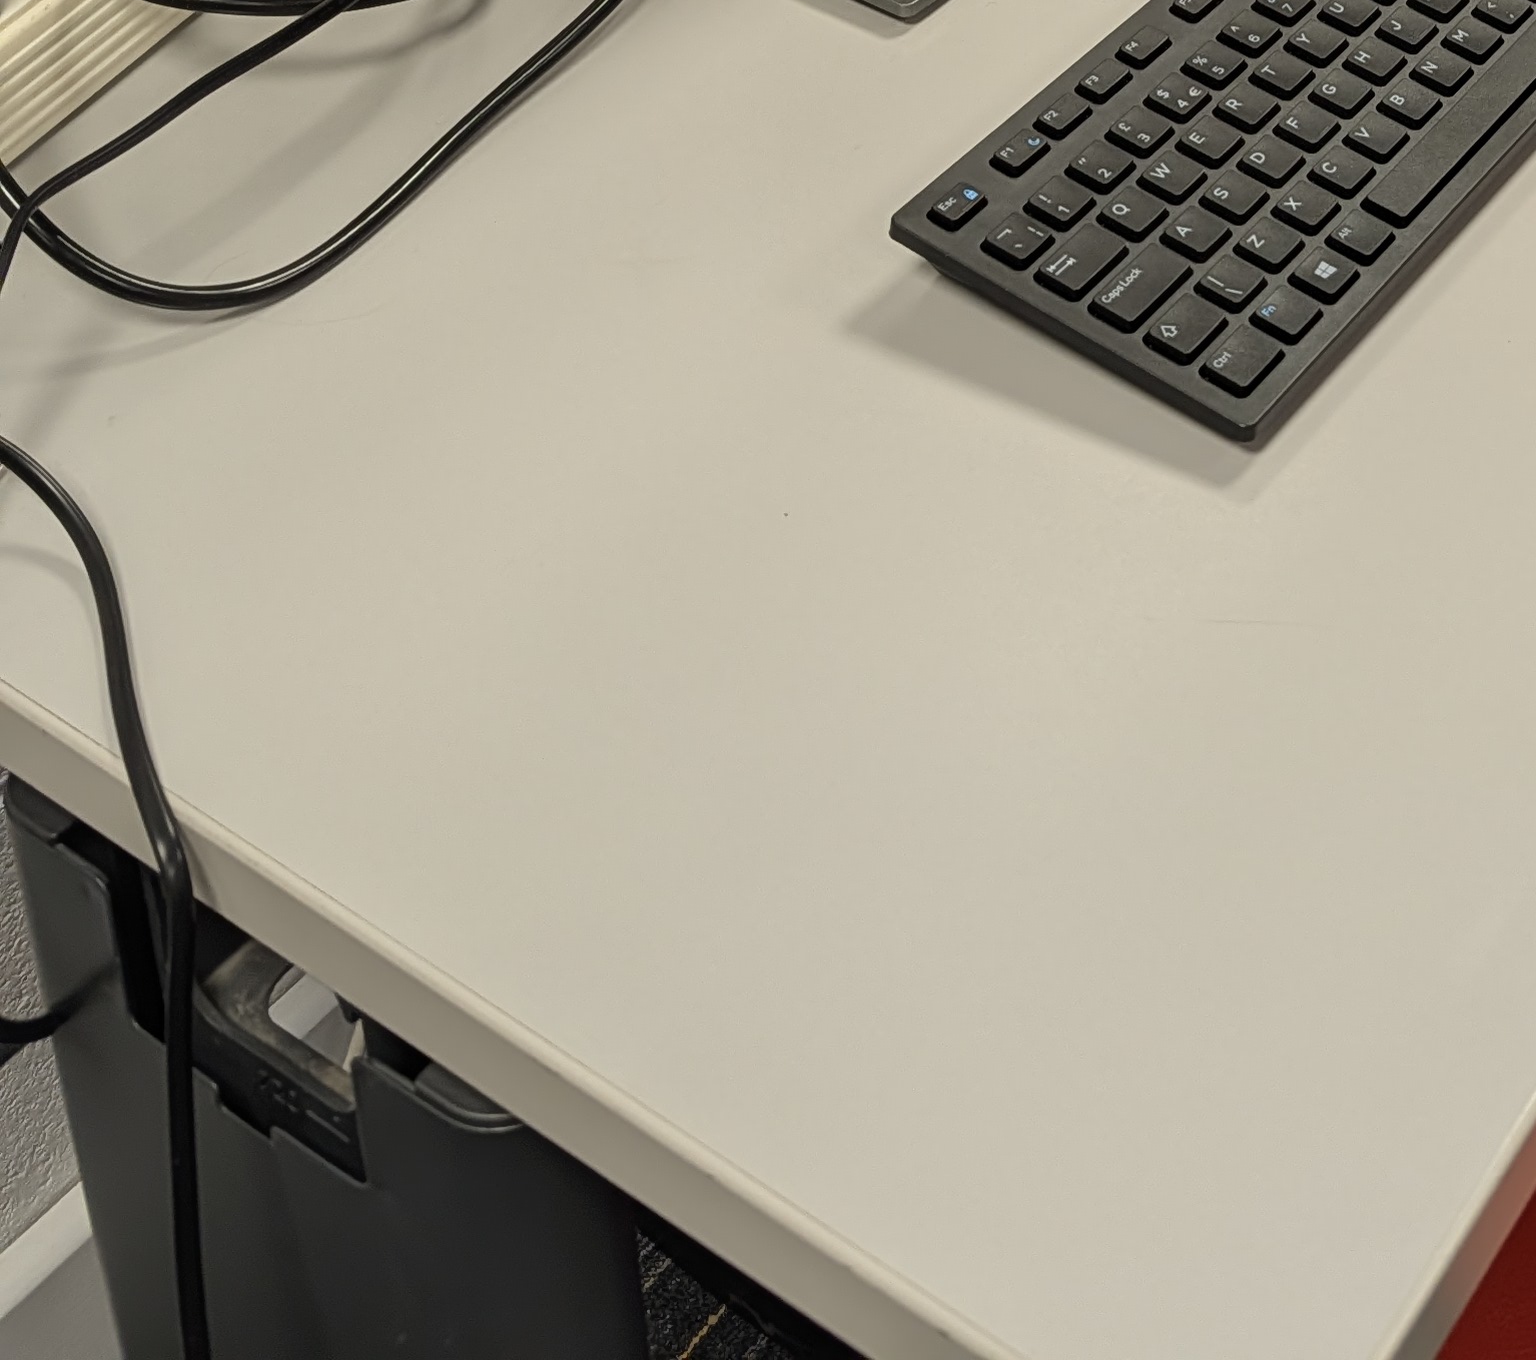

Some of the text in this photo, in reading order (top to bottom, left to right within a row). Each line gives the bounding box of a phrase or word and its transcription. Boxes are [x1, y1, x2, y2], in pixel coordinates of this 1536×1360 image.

[1282, 4, 1293, 12] 7
[1329, 2, 1344, 13] U
[1390, 20, 1401, 31] J
[1248, 34, 1260, 43] 6
[1296, 33, 1311, 44] Y
[1452, 29, 1469, 42] M
[1126, 41, 1138, 51] F4
[1354, 50, 1371, 63] H
[1212, 65, 1224, 75] 5
[1261, 65, 1276, 75] T
[1421, 61, 1438, 73] N
[1085, 75, 1099, 85] F3
[1322, 84, 1337, 94] G
[1177, 99, 1189, 108] 4
[1225, 98, 1243, 110] R
[1389, 94, 1405, 105] B
[1044, 110, 1058, 121] F2
[1286, 117, 1299, 129] F
[1137, 133, 1150, 142] 3
[1354, 127, 1370, 138] V
[1189, 133, 1206, 144] E
[1001, 147, 1014, 158] F1
[1250, 153, 1265, 164] D
[1098, 168, 1112, 178] 2
[1151, 164, 1171, 179] W
[1322, 162, 1337, 173] C
[1214, 187, 1229, 199] S
[939, 197, 956, 211] Esc
[1112, 203, 1130, 215] Q
[1284, 197, 1302, 211] X
[1176, 226, 1192, 237] A
[1247, 235, 1265, 248] Z
[1101, 268, 1143, 304] Caps Lock
[1262, 305, 1277, 316] Fn
[1213, 352, 1231, 368] Ctrl
